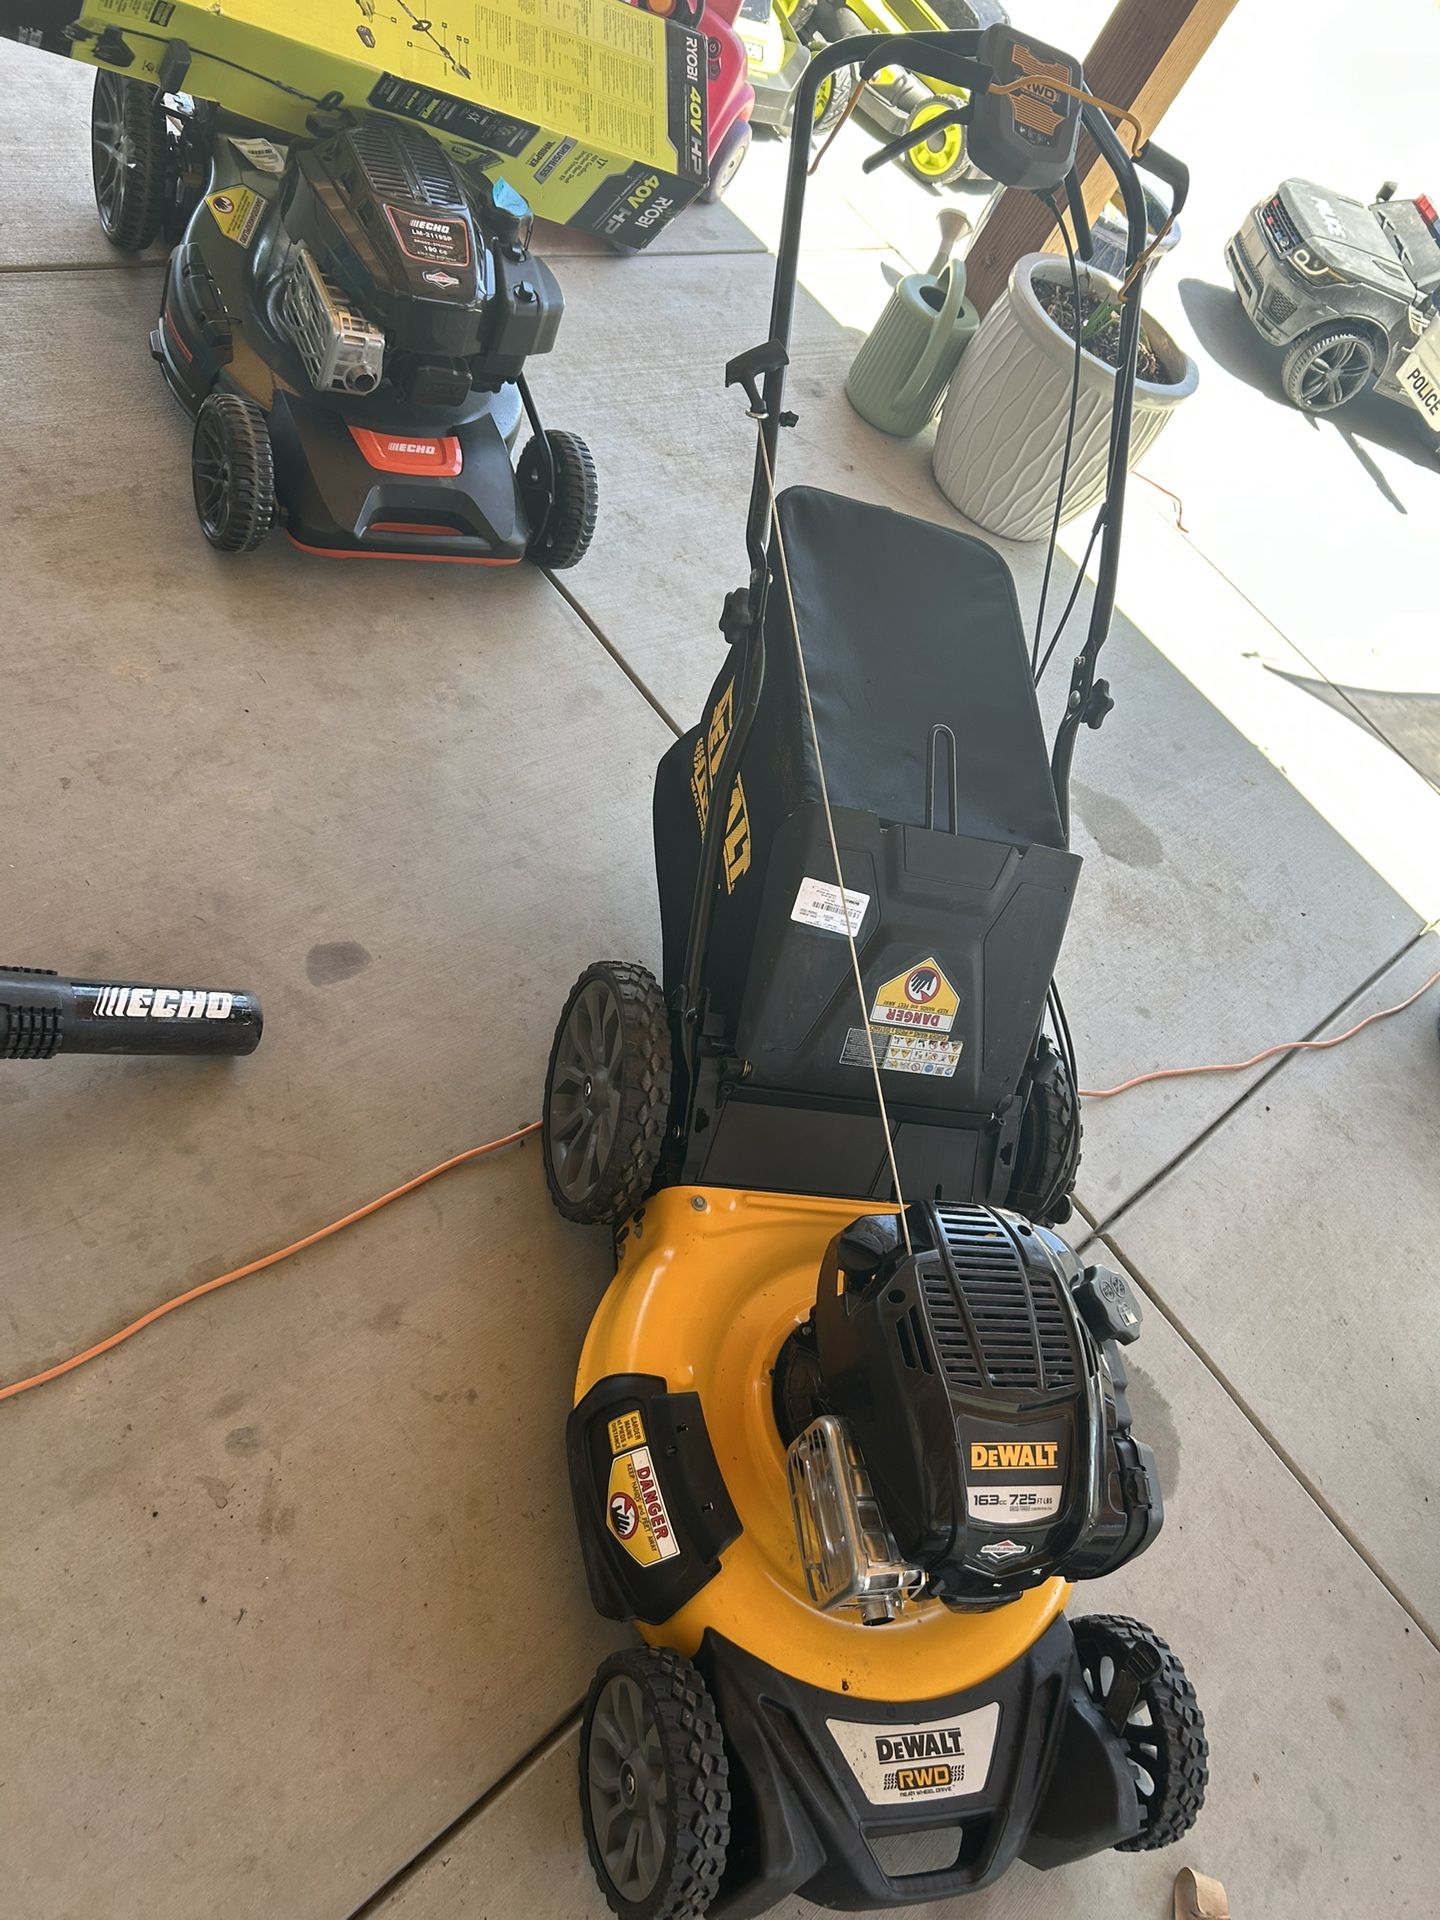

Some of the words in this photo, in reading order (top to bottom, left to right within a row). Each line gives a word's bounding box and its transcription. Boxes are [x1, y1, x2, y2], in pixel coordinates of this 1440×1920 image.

[686, 36, 698, 82] RYOBI
[689, 86, 702, 135] 40V
[528, 138, 556, 169] WHISPER
[539, 143, 571, 178] BRUSHLESS
[691, 136, 702, 176] HP
[627, 175, 660, 209] 40V
[418, 220, 450, 234] ECHO
[605, 207, 632, 234] HP
[634, 197, 674, 228] RYOBI
[1407, 367, 1440, 416] POLICE
[399, 443, 436, 455] ECHO
[126, 987, 233, 1019] ECHO
[886, 1008, 941, 1026] DANGER
[611, 1422, 619, 1450] DISTANCE
[618, 1425, 627, 1444] PIEDS
[623, 1420, 633, 1440] MAINS
[630, 1416, 641, 1440] GARDER
[627, 1463, 635, 1479] KEEP
[632, 1481, 641, 1503] HANDS
[641, 1516, 651, 1532] FEET
[647, 1535, 657, 1552] AWAY
[636, 1466, 669, 1540] DANGER
[1009, 1494, 1037, 1506] 7.25
[899, 1766, 951, 1789] RWD
[935, 1786, 952, 1794] DRIVE
